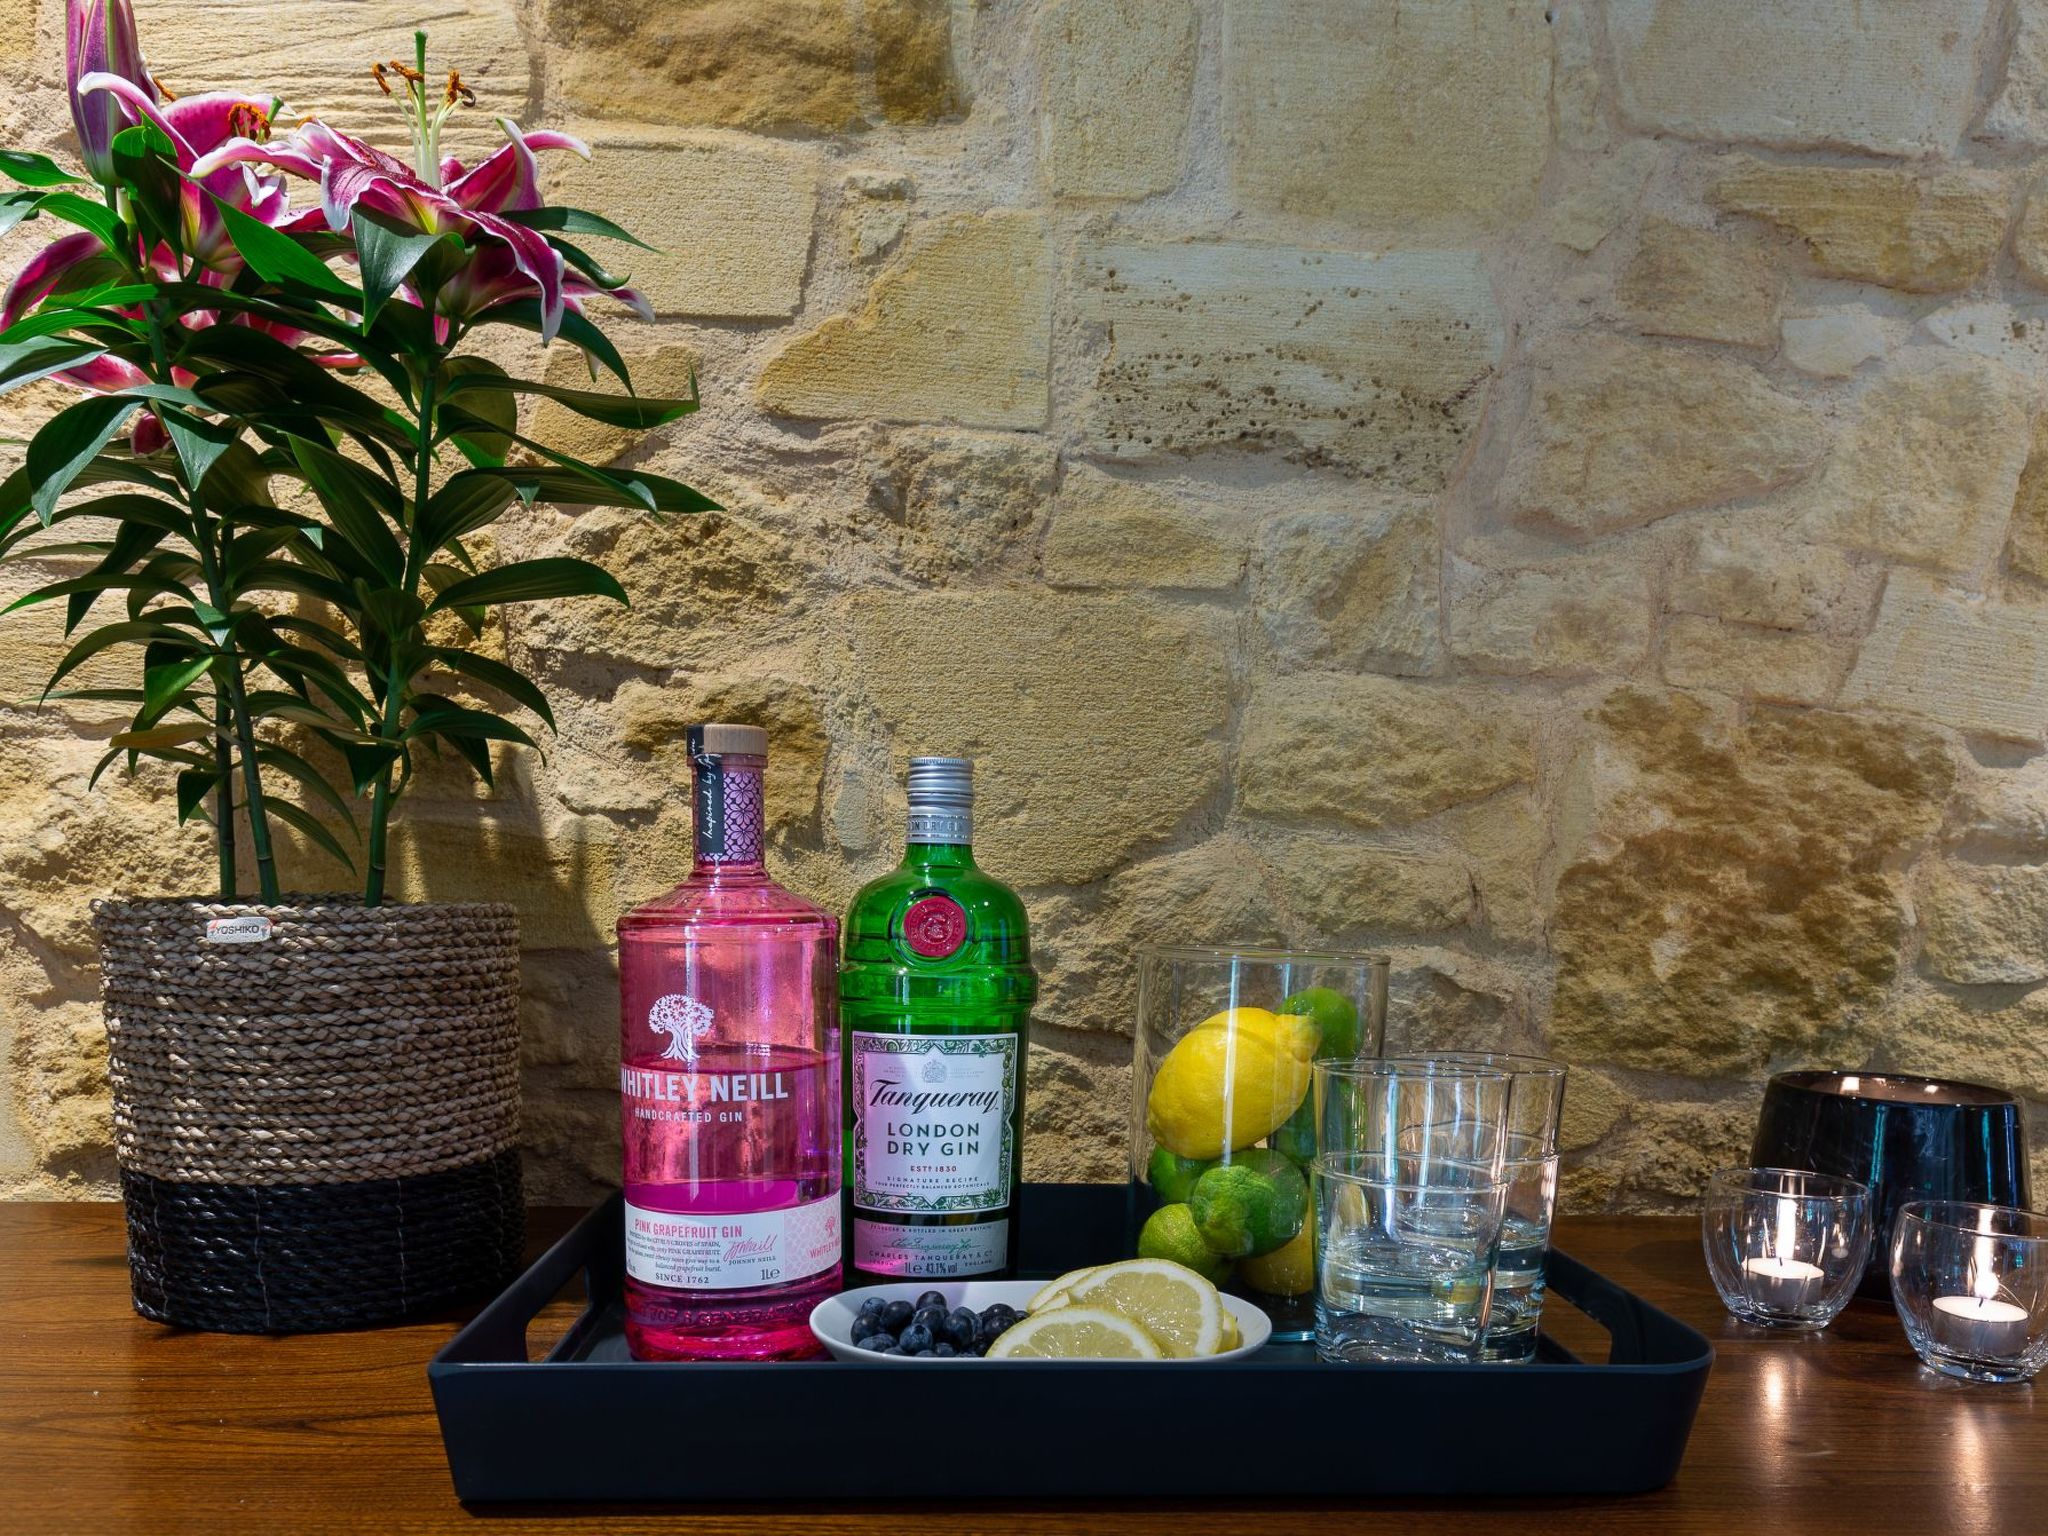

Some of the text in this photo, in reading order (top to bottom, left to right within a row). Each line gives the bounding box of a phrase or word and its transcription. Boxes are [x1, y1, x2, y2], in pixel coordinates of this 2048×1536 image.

[216, 925, 260, 935] YOSHIKO
[710, 1072, 789, 1102] NEILL
[870, 1079, 999, 1115] Tanqueray
[634, 1107, 743, 1123] HANDCRAFTED GIN
[888, 1122, 980, 1138] LONDON
[888, 1140, 979, 1156] DRY GIN
[935, 1165, 957, 1173] 1830
[634, 1218, 743, 1239] PINK GRAPEFRUIT GIN
[728, 1258, 757, 1266] JOHNNY
[869, 1250, 909, 1260] CHARLES
[655, 1273, 710, 1284] SINCE 1762
